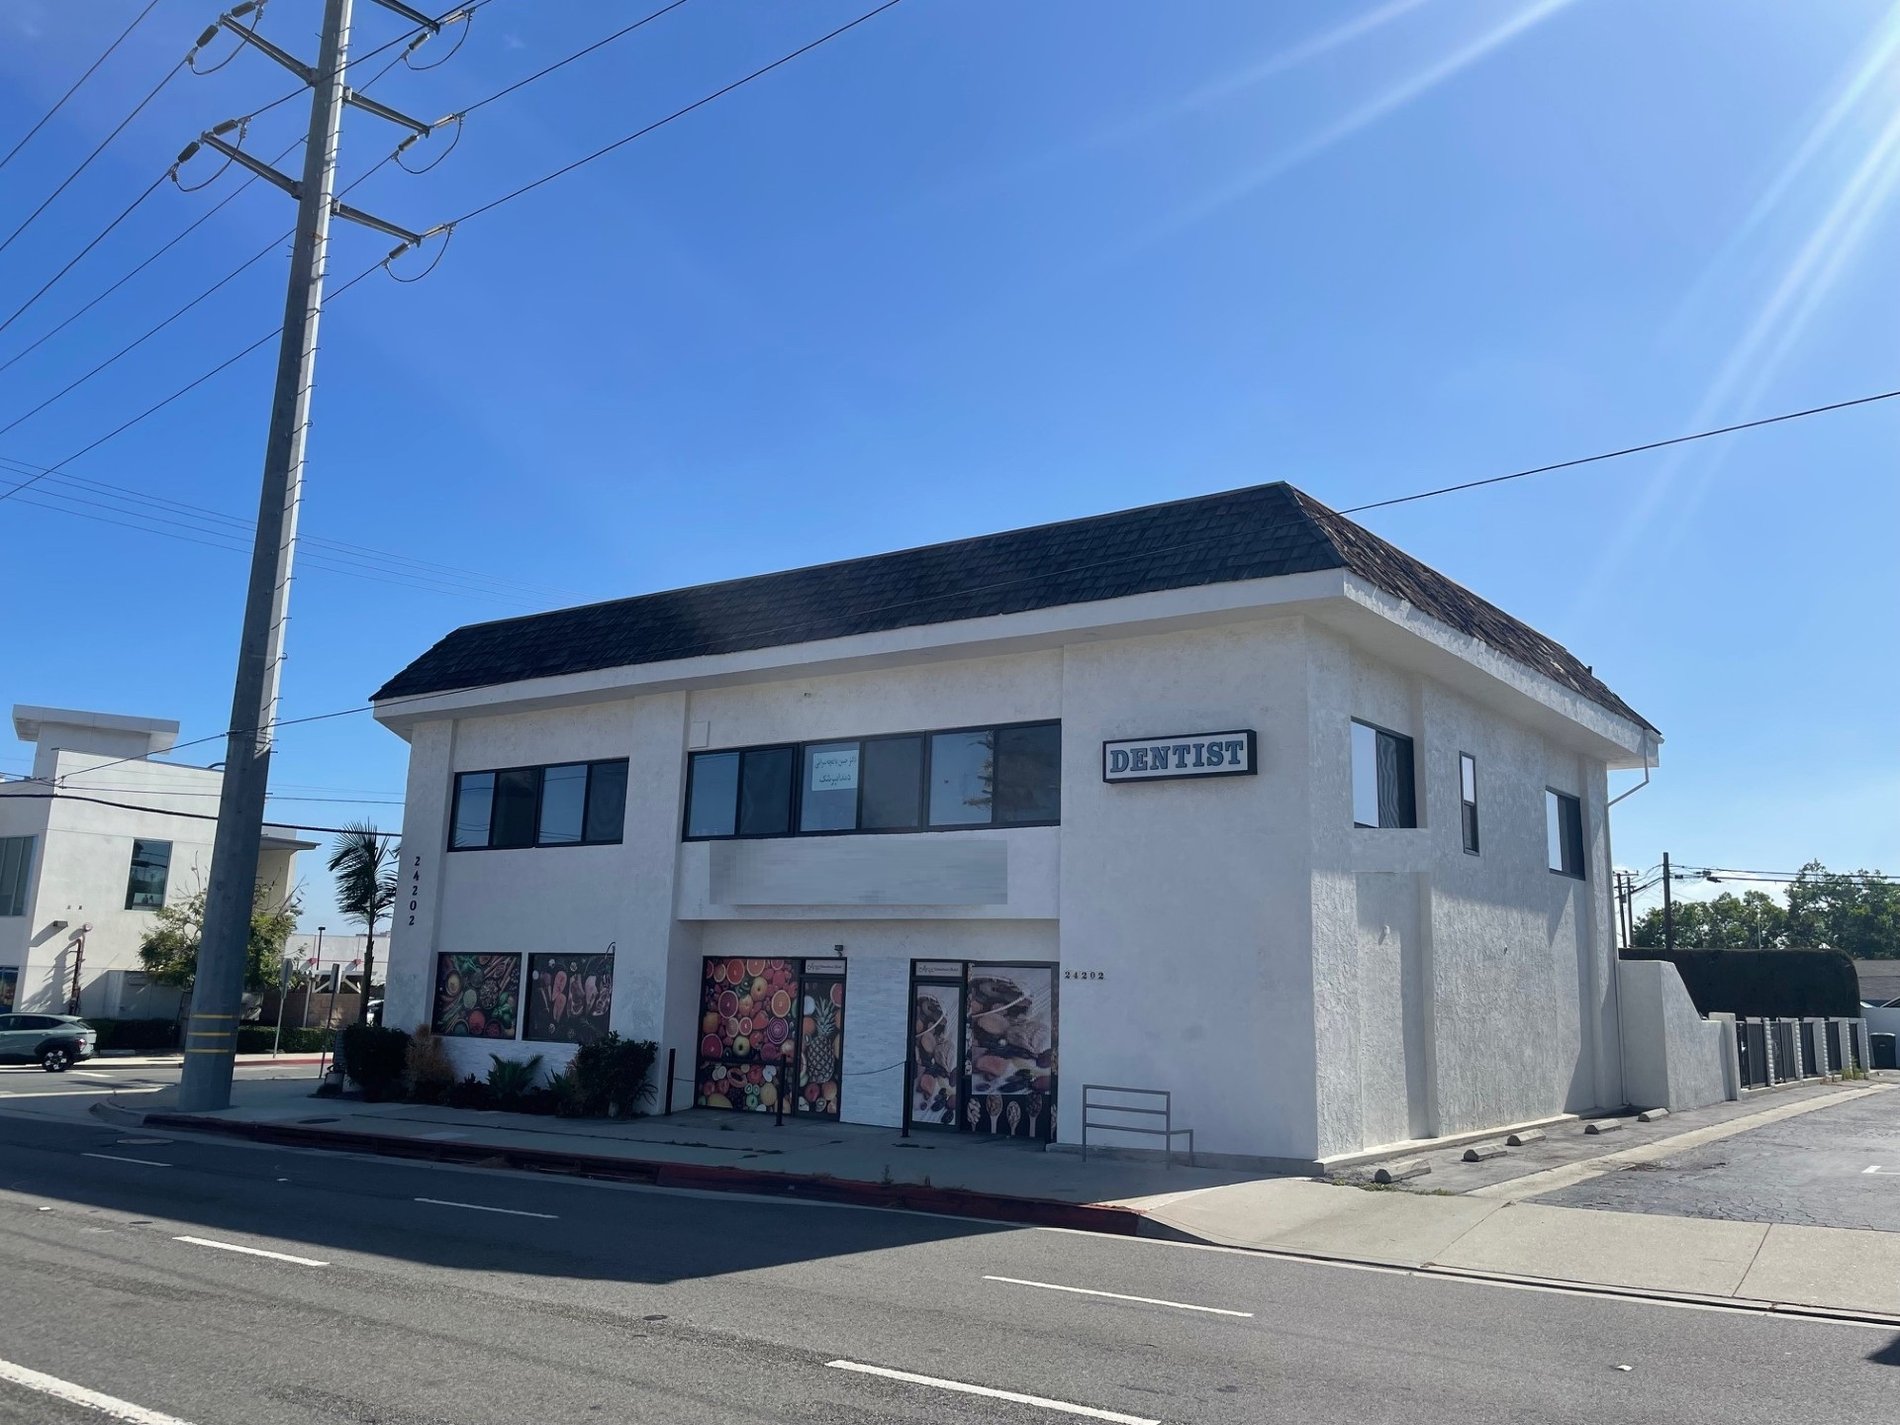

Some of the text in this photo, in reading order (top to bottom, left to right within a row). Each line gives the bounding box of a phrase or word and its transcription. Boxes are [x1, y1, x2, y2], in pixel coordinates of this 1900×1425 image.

[1109, 740, 1244, 773] DENTIST
[408, 856, 420, 926] 24202
[1064, 971, 1104, 980] 24202
